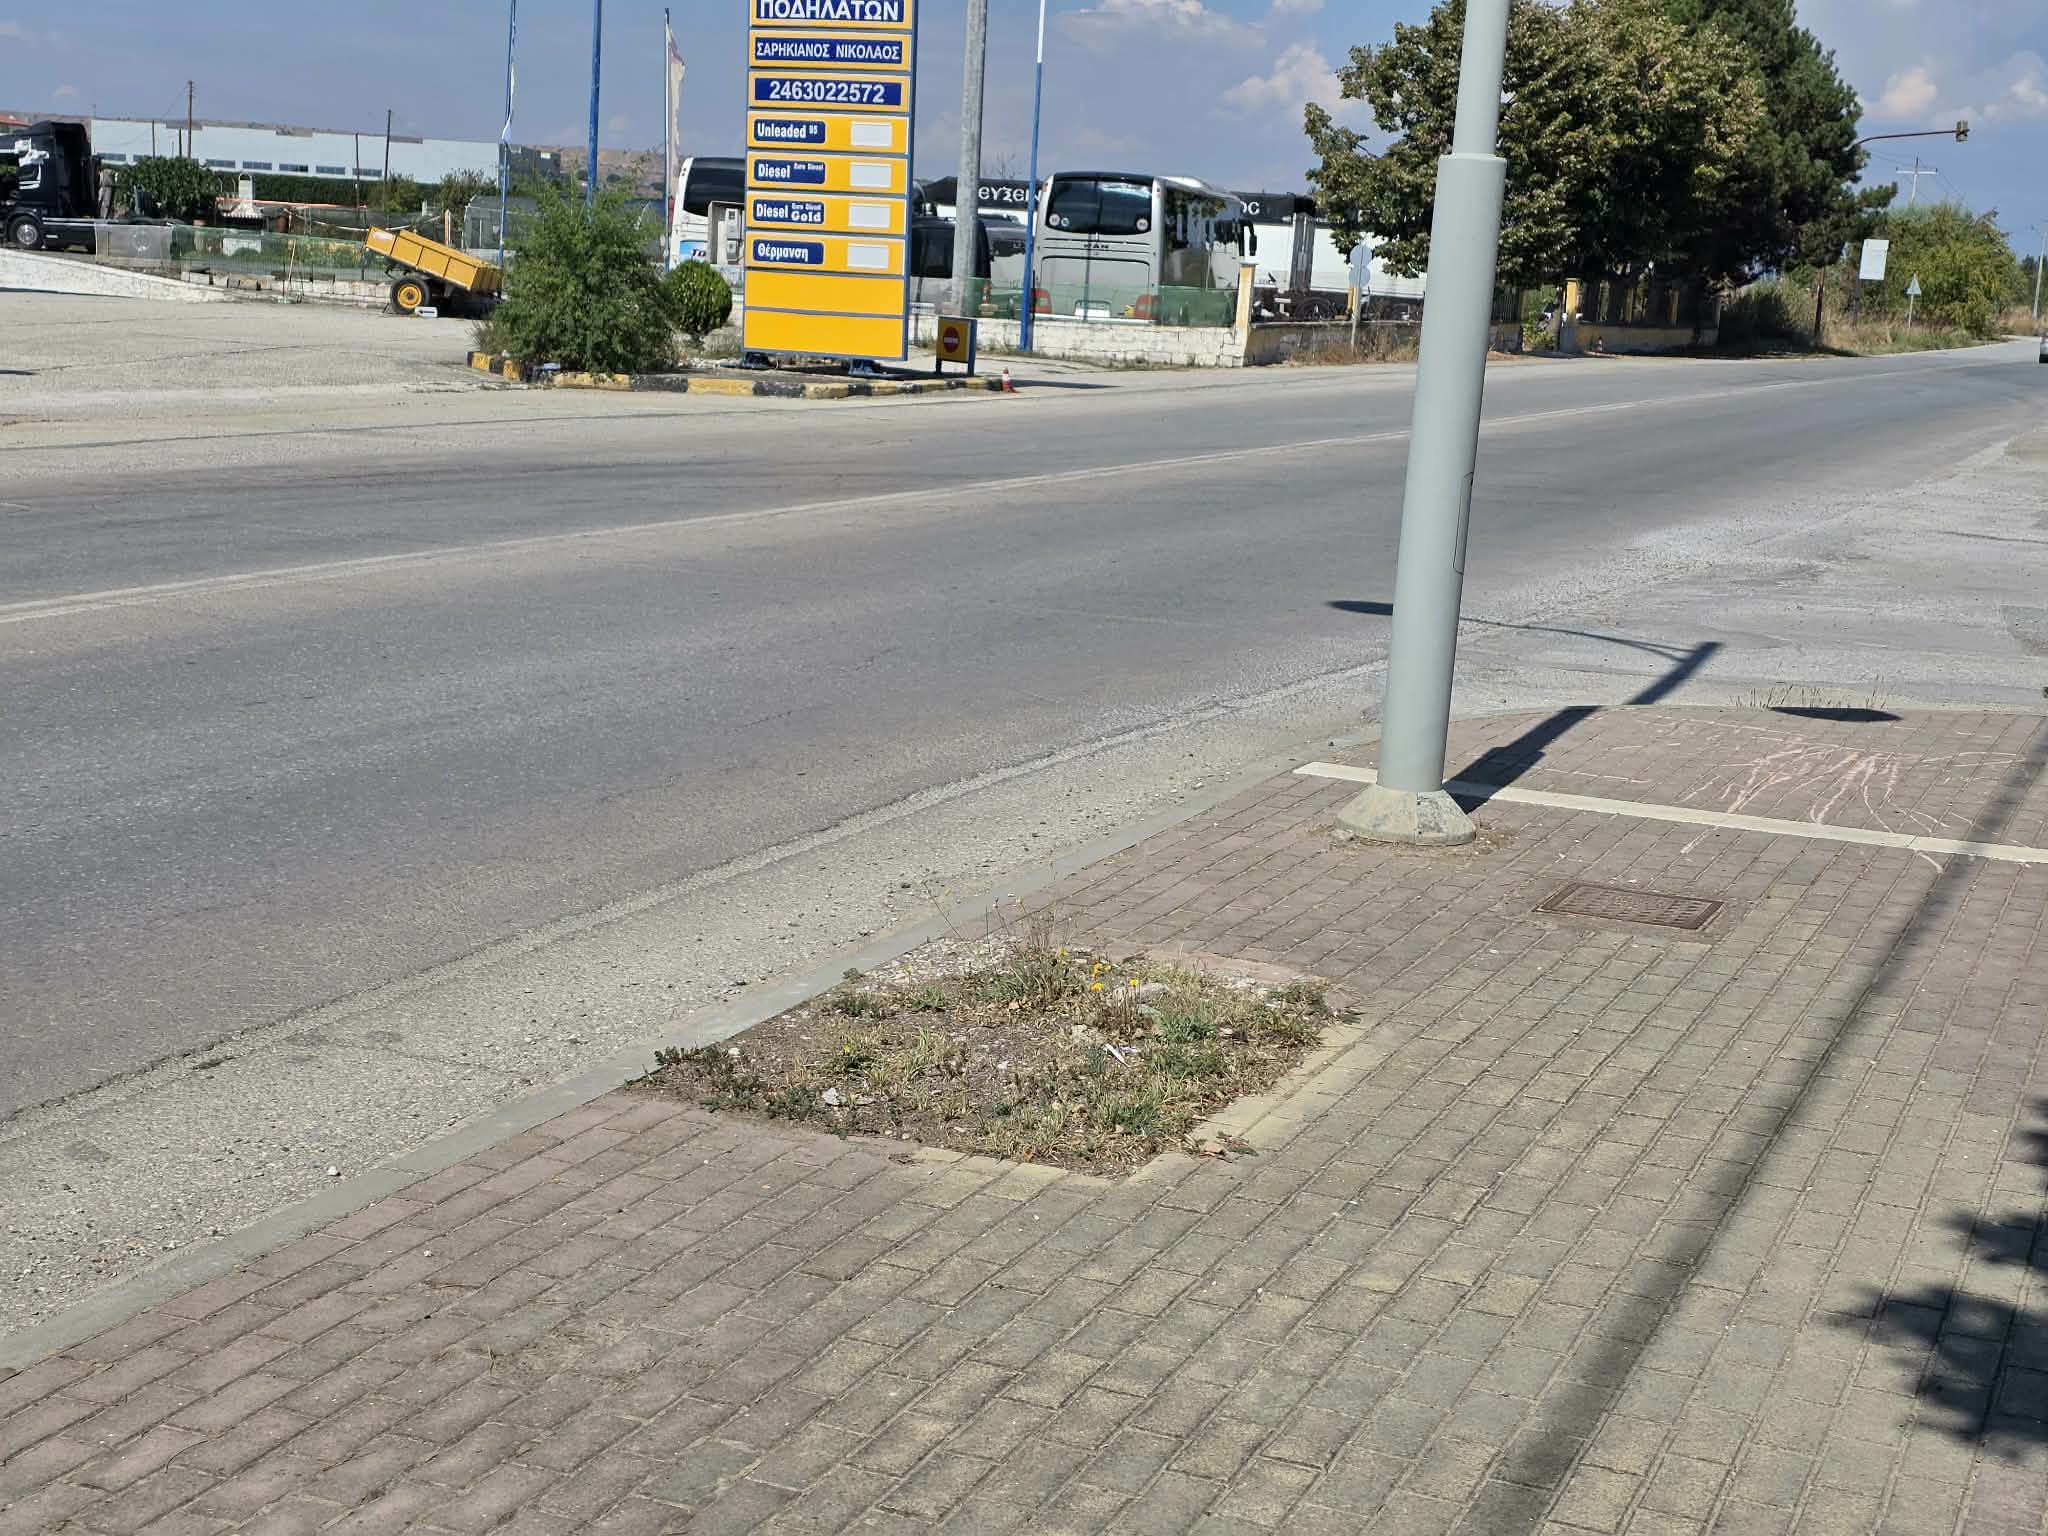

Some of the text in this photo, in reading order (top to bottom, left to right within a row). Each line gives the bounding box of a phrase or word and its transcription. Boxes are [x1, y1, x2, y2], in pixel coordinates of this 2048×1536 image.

[759, 0, 899, 21] ΠΟΔΗΛΑΤΩΝ
[756, 42, 900, 60] ΣΑΡΗΚΙΑΝΟΣ ΝΙΚΟΛΑΟΣ
[770, 80, 885, 103] 2463022572
[757, 123, 806, 139] Unleaded
[757, 163, 791, 179] Diesel
[756, 203, 789, 219] Diesel
[757, 243, 809, 262] Θέρμανση
